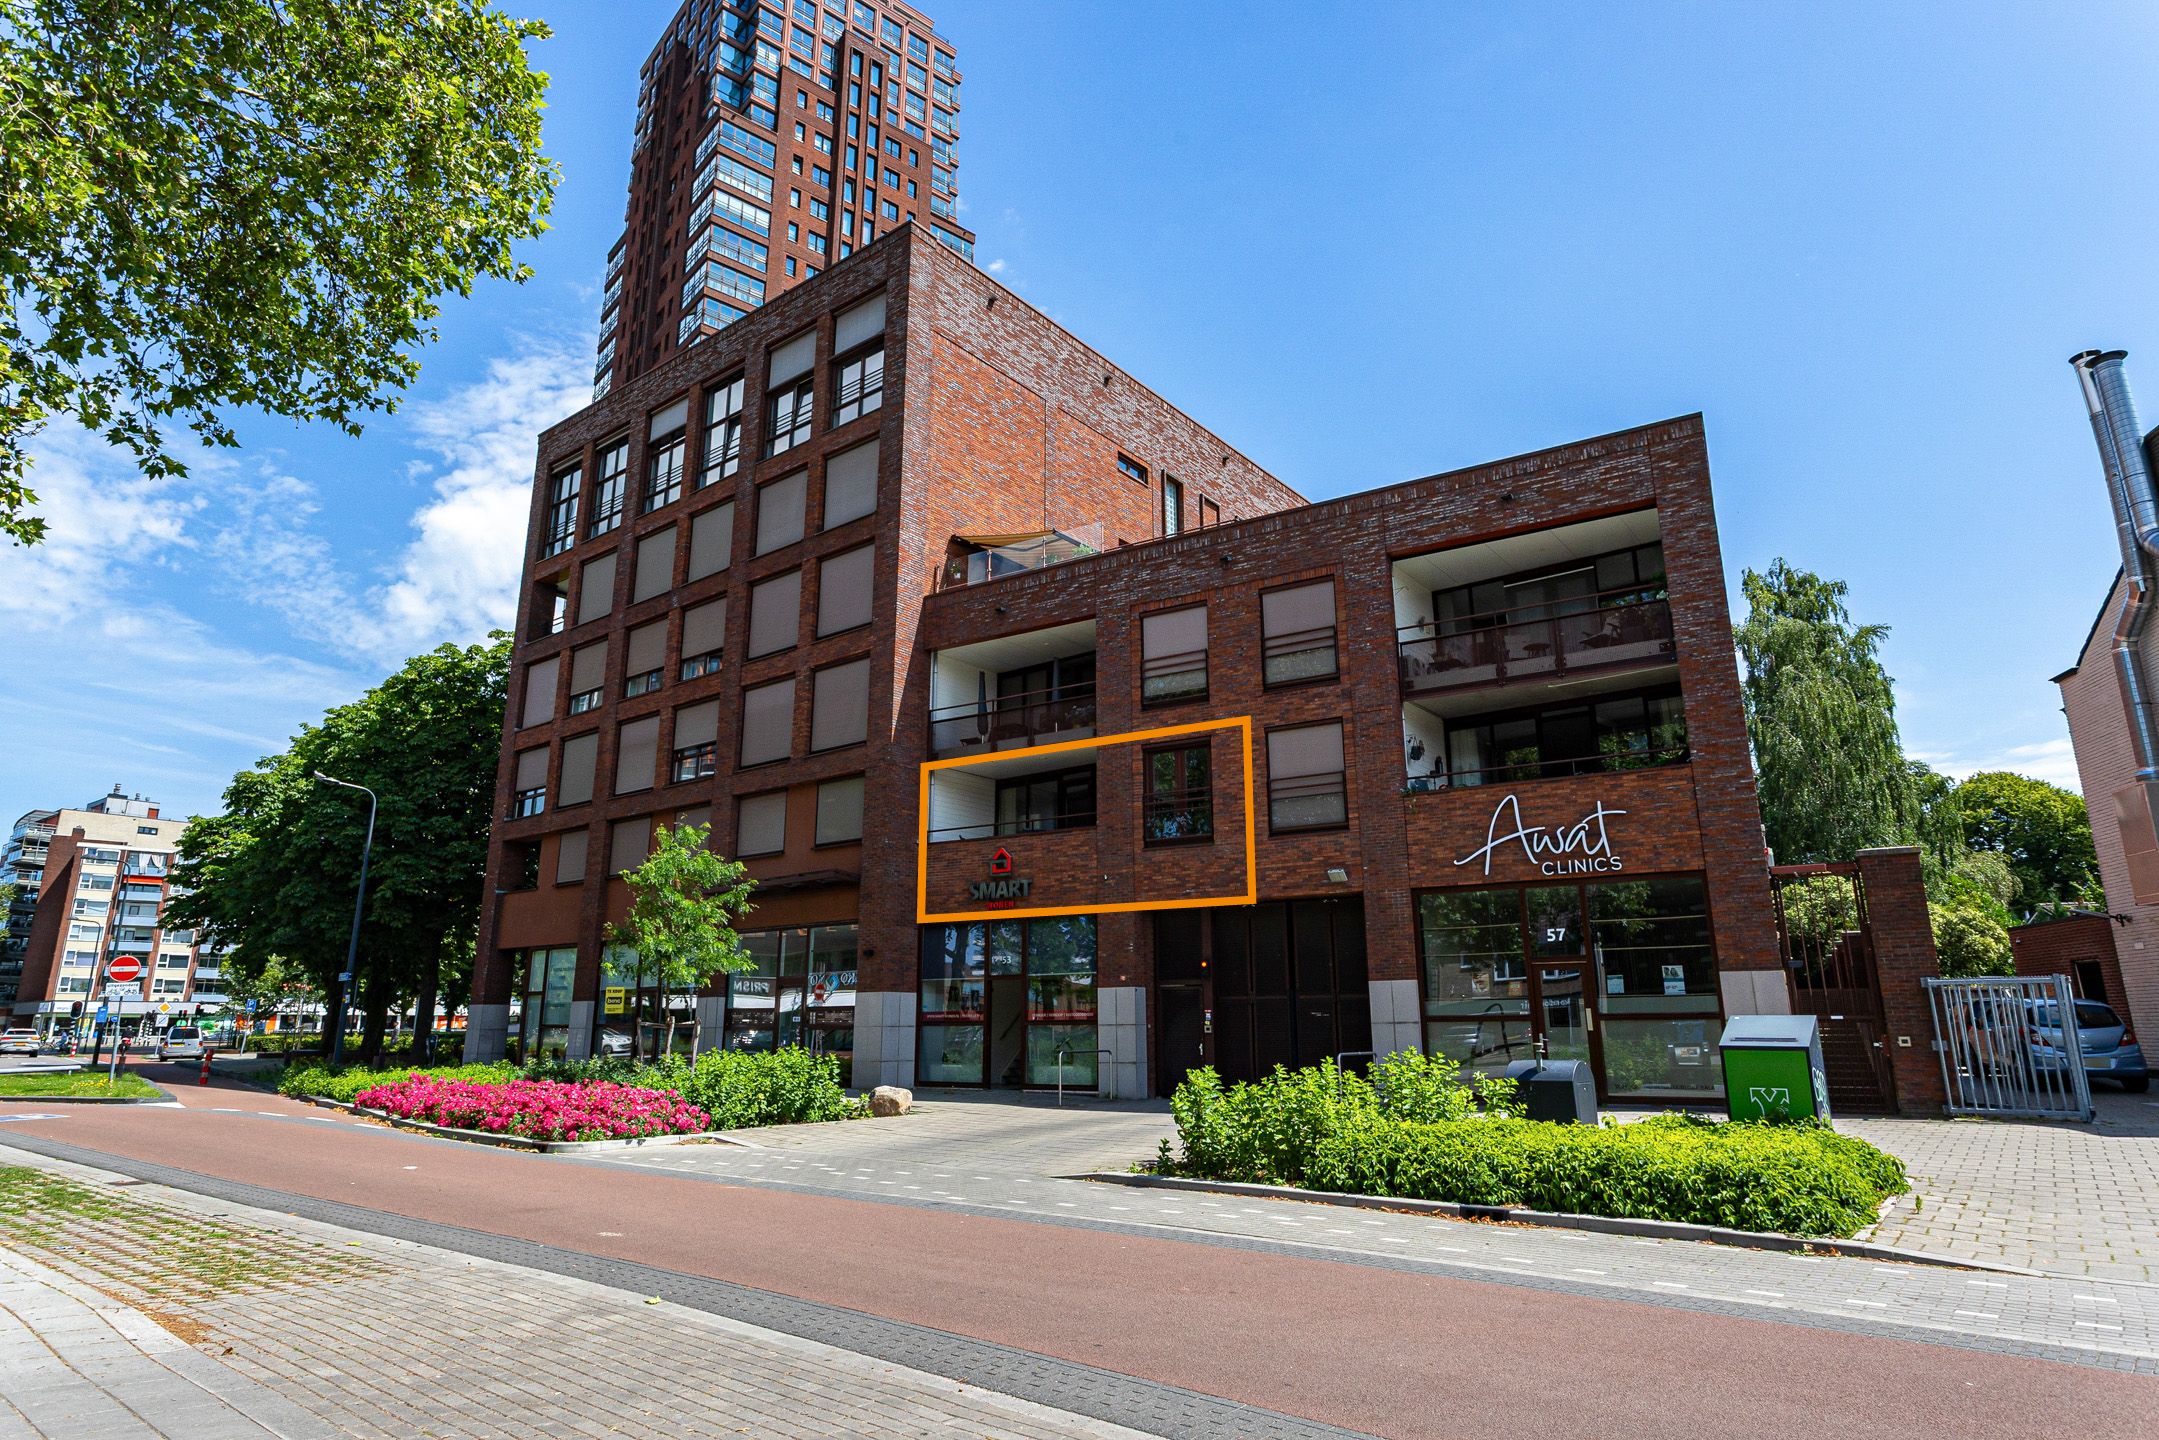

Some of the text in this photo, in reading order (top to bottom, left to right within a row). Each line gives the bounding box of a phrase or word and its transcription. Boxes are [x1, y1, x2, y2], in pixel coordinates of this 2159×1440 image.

[1453, 794, 1627, 876] Awat
[1541, 856, 1623, 876] CLINICS
[969, 879, 1033, 900] SMART
[1546, 927, 1566, 942] 57
[1002, 955, 1012, 964] 53
